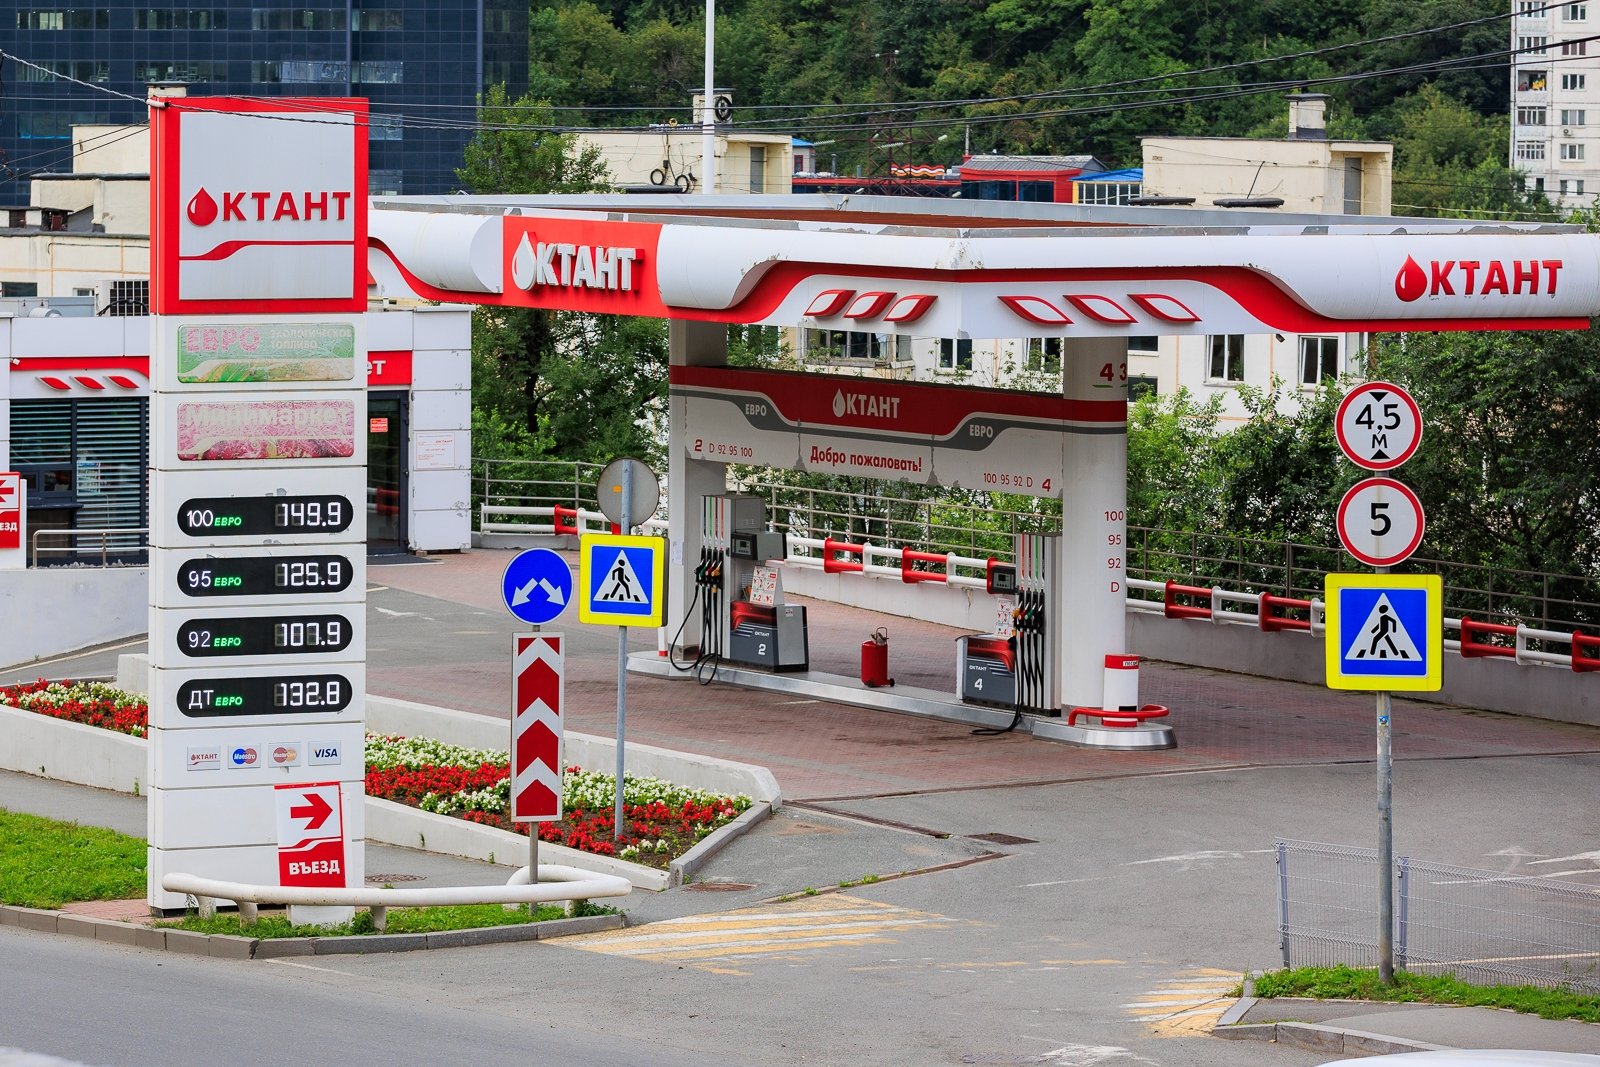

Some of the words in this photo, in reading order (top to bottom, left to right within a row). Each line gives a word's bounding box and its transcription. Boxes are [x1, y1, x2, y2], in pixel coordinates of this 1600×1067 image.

[186, 327, 261, 353] ЕВРО
[1100, 363, 1114, 382] 4
[1119, 363, 1127, 382] 3
[745, 403, 767, 417] ЕВРО
[1355, 403, 1401, 434] 4,5
[969, 424, 994, 438] ЕВРО
[694, 439, 703, 452] 2
[709, 443, 715, 453] D
[718, 444, 727, 454] 92
[729, 445, 738, 456] 95
[741, 447, 753, 458] 100
[810, 446, 846, 467] Добро
[850, 453, 922, 473] пожаловать!
[983, 473, 997, 484] 100
[1000, 474, 1010, 485] 95
[1013, 475, 1023, 487] 92
[1026, 476, 1033, 488] D
[1041, 478, 1051, 492] 4
[186, 509, 214, 527] 100
[214, 516, 242, 527] ЕВРО
[281, 502, 341, 527] 149.9
[1104, 510, 1124, 521] 100
[1370, 503, 1392, 536] 5
[1108, 534, 1122, 545] 95
[1107, 557, 1121, 569] 92
[188, 570, 212, 588] 95
[214, 576, 242, 587] ЕВРО
[281, 562, 341, 586] 125.9
[1110, 581, 1120, 592] D
[188, 630, 211, 648] 92
[213, 637, 242, 647] ЕВРО
[281, 621, 341, 646] 107.9
[758, 643, 766, 655] 2
[974, 678, 983, 690] 4
[188, 689, 214, 709] ДТ
[215, 696, 243, 706] ЕВРО
[281, 681, 340, 706] 132.8
[233, 752, 256, 760] Maestro
[314, 748, 338, 758] VISA
[288, 859, 340, 875] ВЪЕЗД
